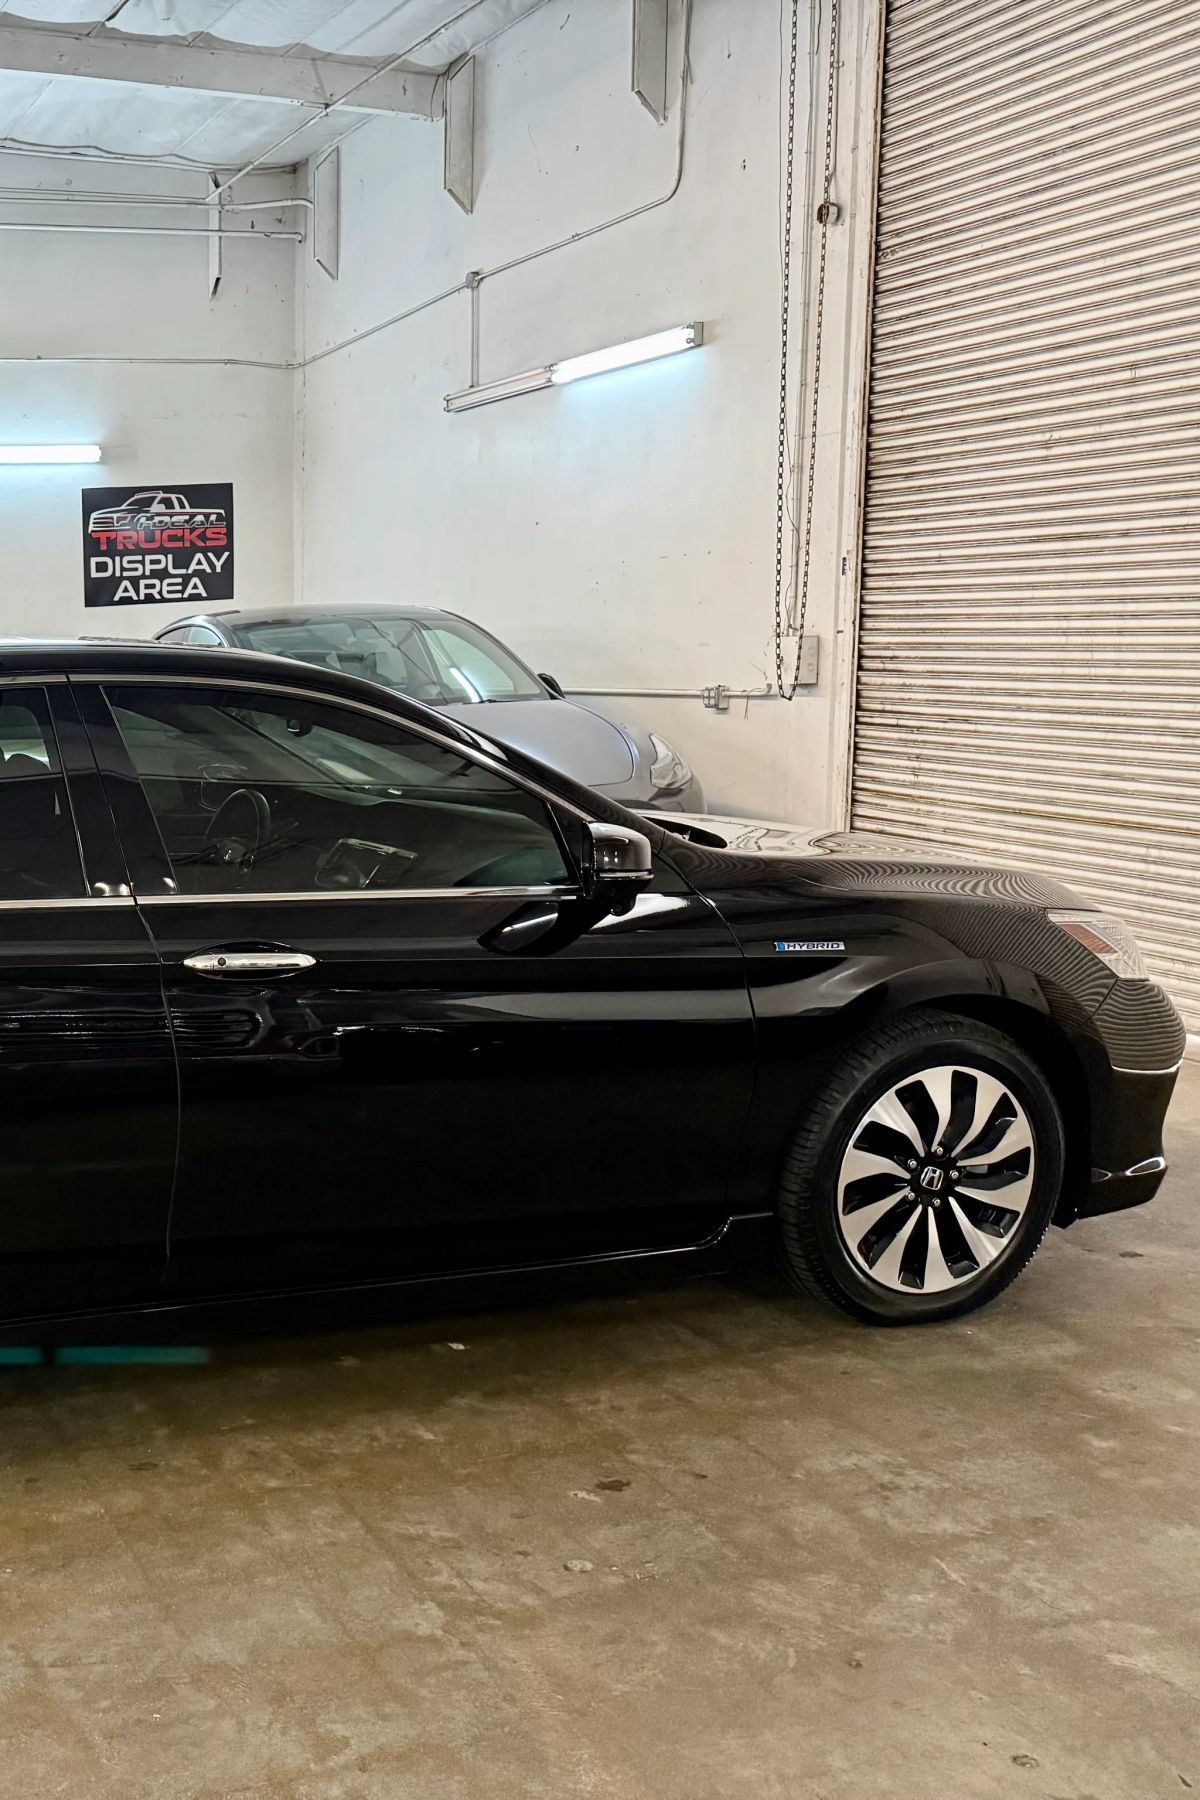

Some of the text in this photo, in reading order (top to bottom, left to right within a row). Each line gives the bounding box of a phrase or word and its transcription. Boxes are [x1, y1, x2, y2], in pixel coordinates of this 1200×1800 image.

[137, 514, 227, 530] I-DEAL
[90, 527, 228, 551] TRUCKS
[90, 551, 230, 578] DISPLAY
[113, 576, 208, 601] AREA
[786, 942, 840, 950] HYBRID
